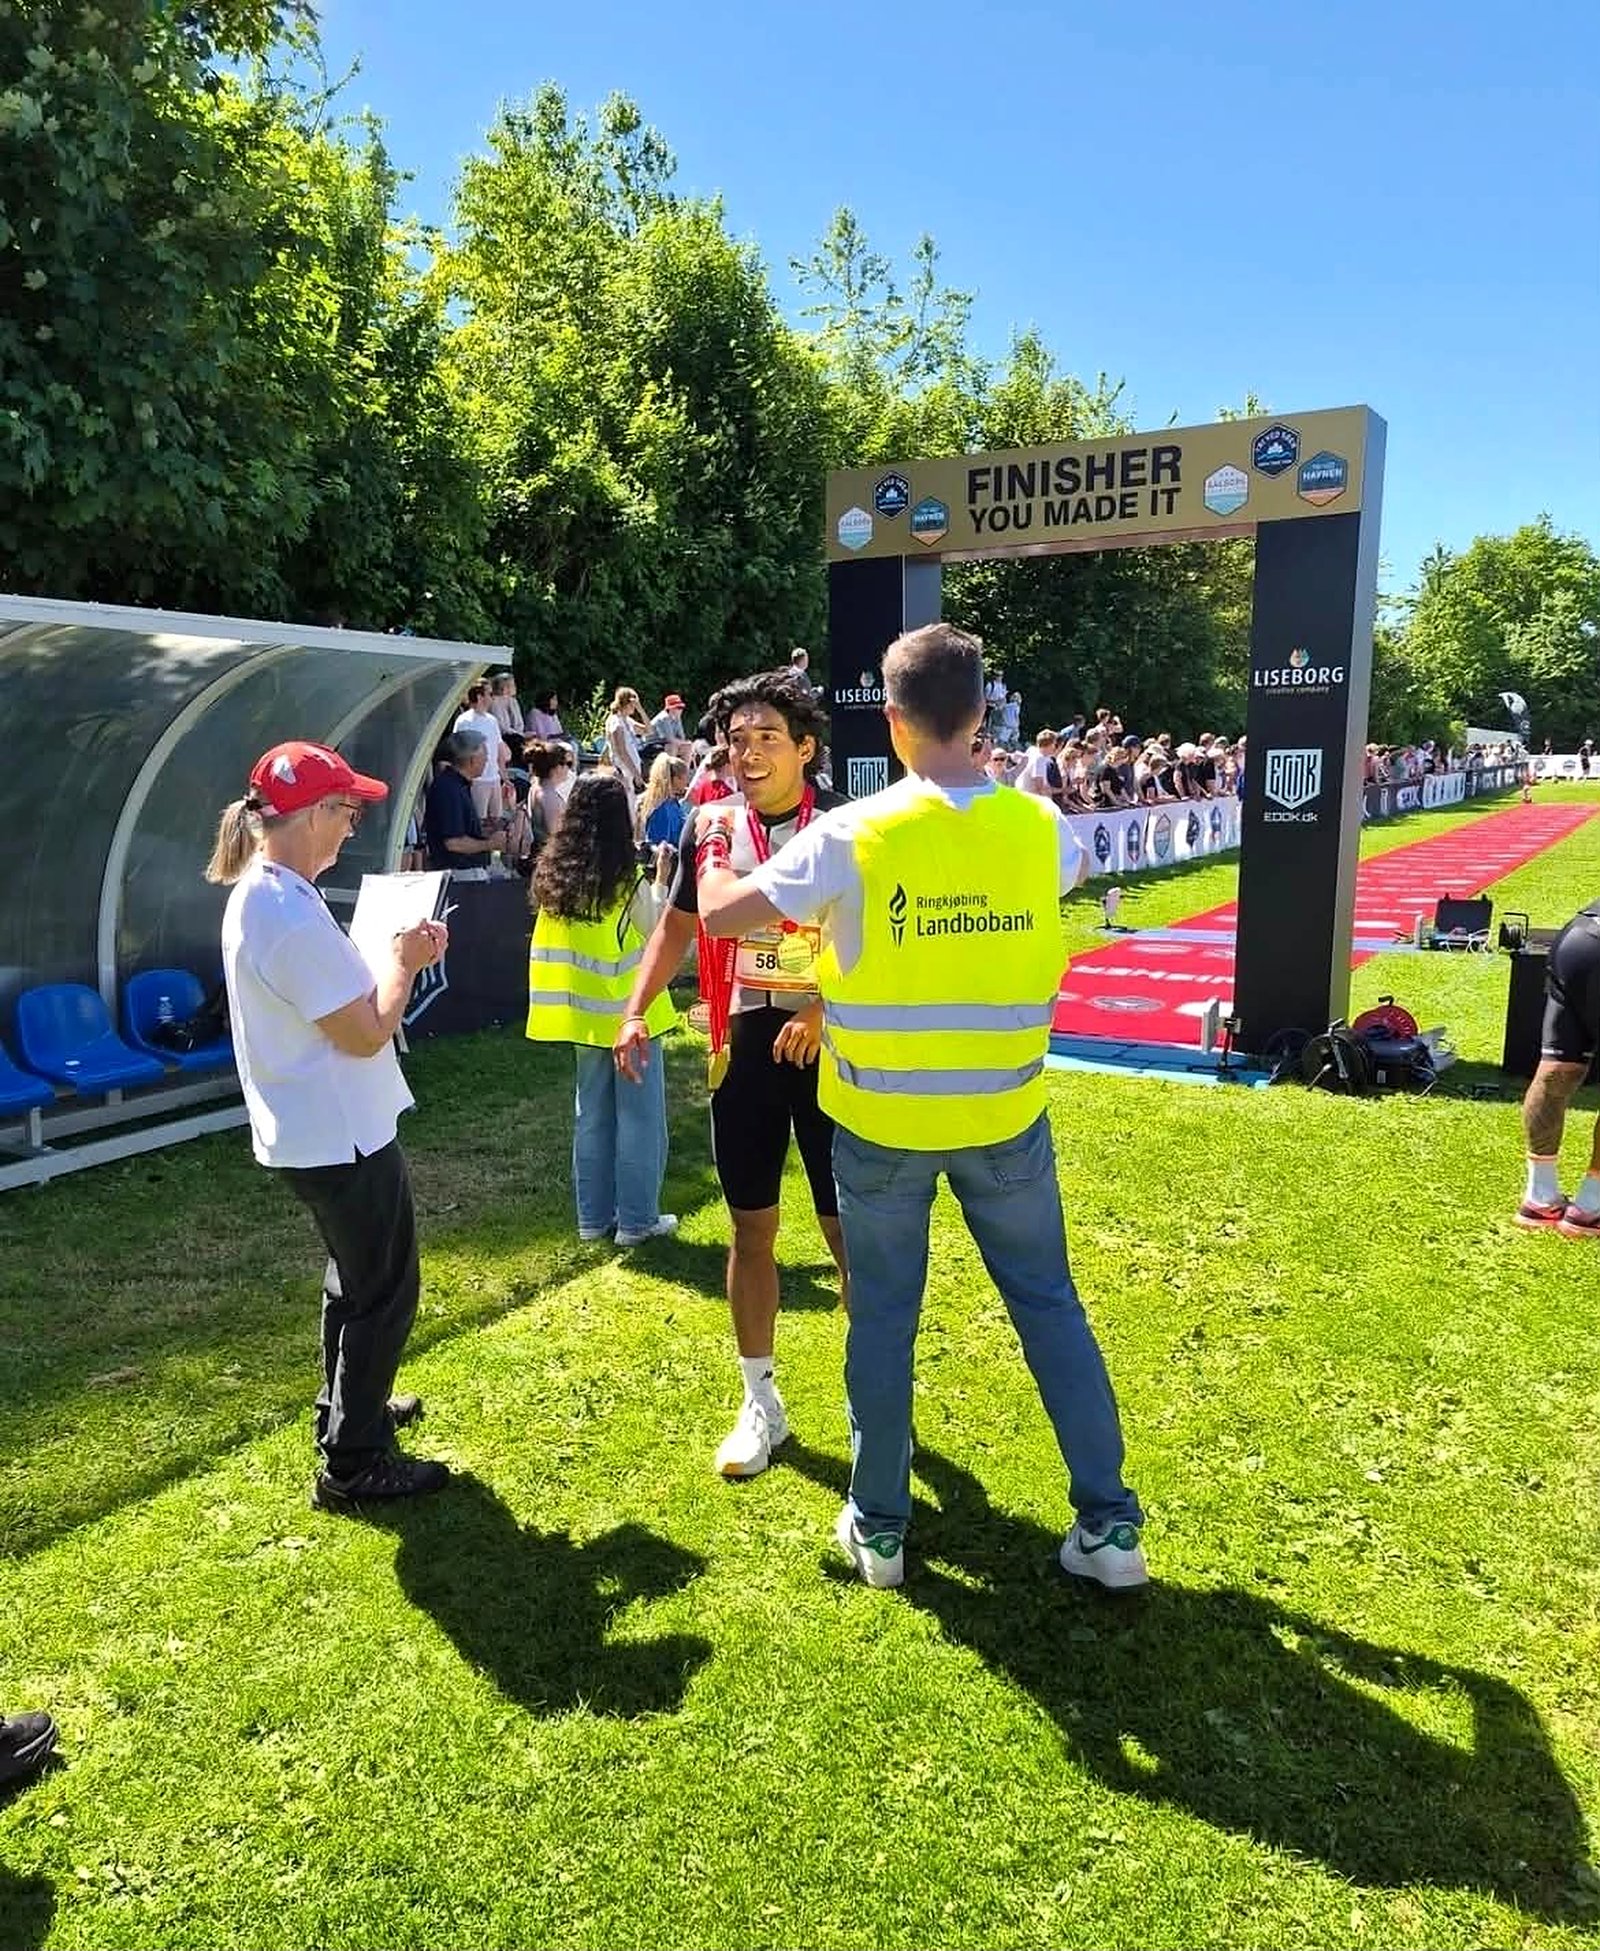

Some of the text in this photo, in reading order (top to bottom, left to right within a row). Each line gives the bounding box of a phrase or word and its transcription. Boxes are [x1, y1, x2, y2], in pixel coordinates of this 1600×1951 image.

[967, 445, 1182, 504] FINISHER
[969, 487, 1181, 534] YOU MADE IT
[1254, 666, 1344, 687] LISEBORG
[916, 893, 988, 910] Ringkjøbing
[917, 910, 1034, 937] Landbobank
